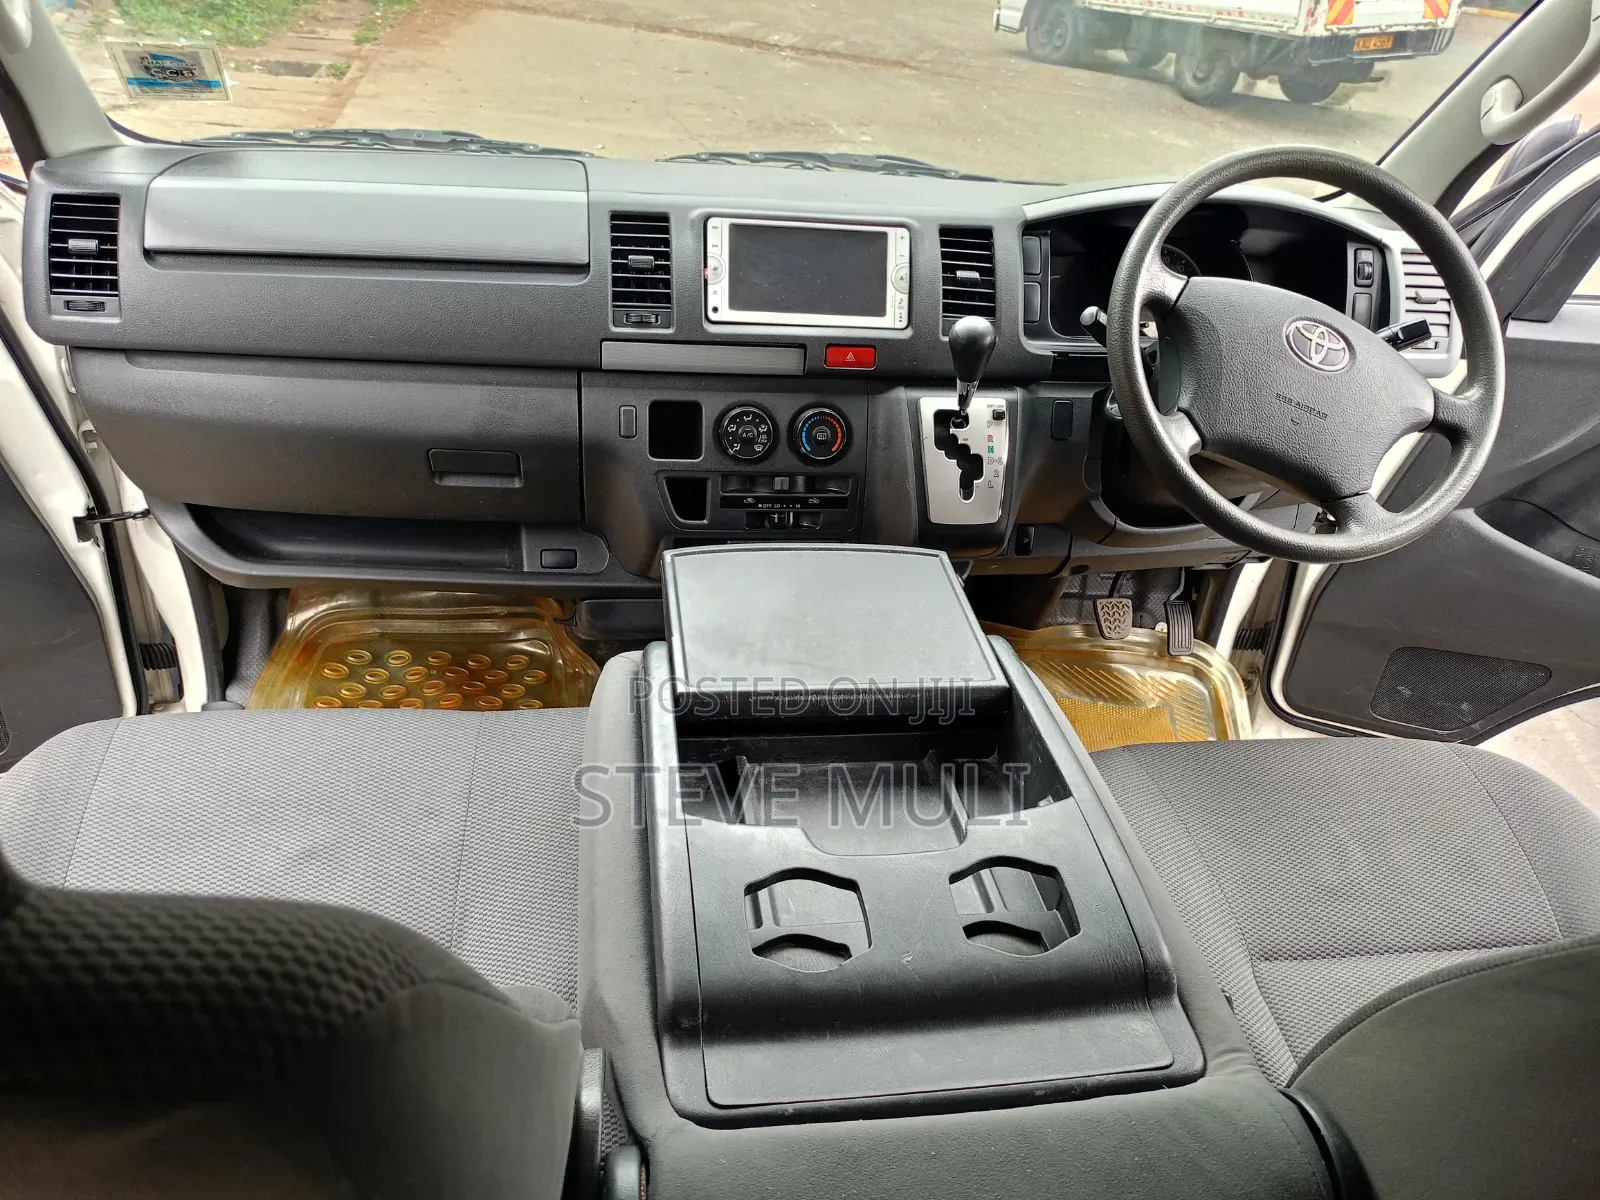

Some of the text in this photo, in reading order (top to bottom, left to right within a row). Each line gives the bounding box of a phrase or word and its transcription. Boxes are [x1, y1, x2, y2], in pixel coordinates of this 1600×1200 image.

[1171, 264, 1185, 272] 120
[987, 420, 993, 428] P
[987, 445, 995, 453] N
[993, 469, 1000, 477] 2
[988, 480, 994, 488] L
